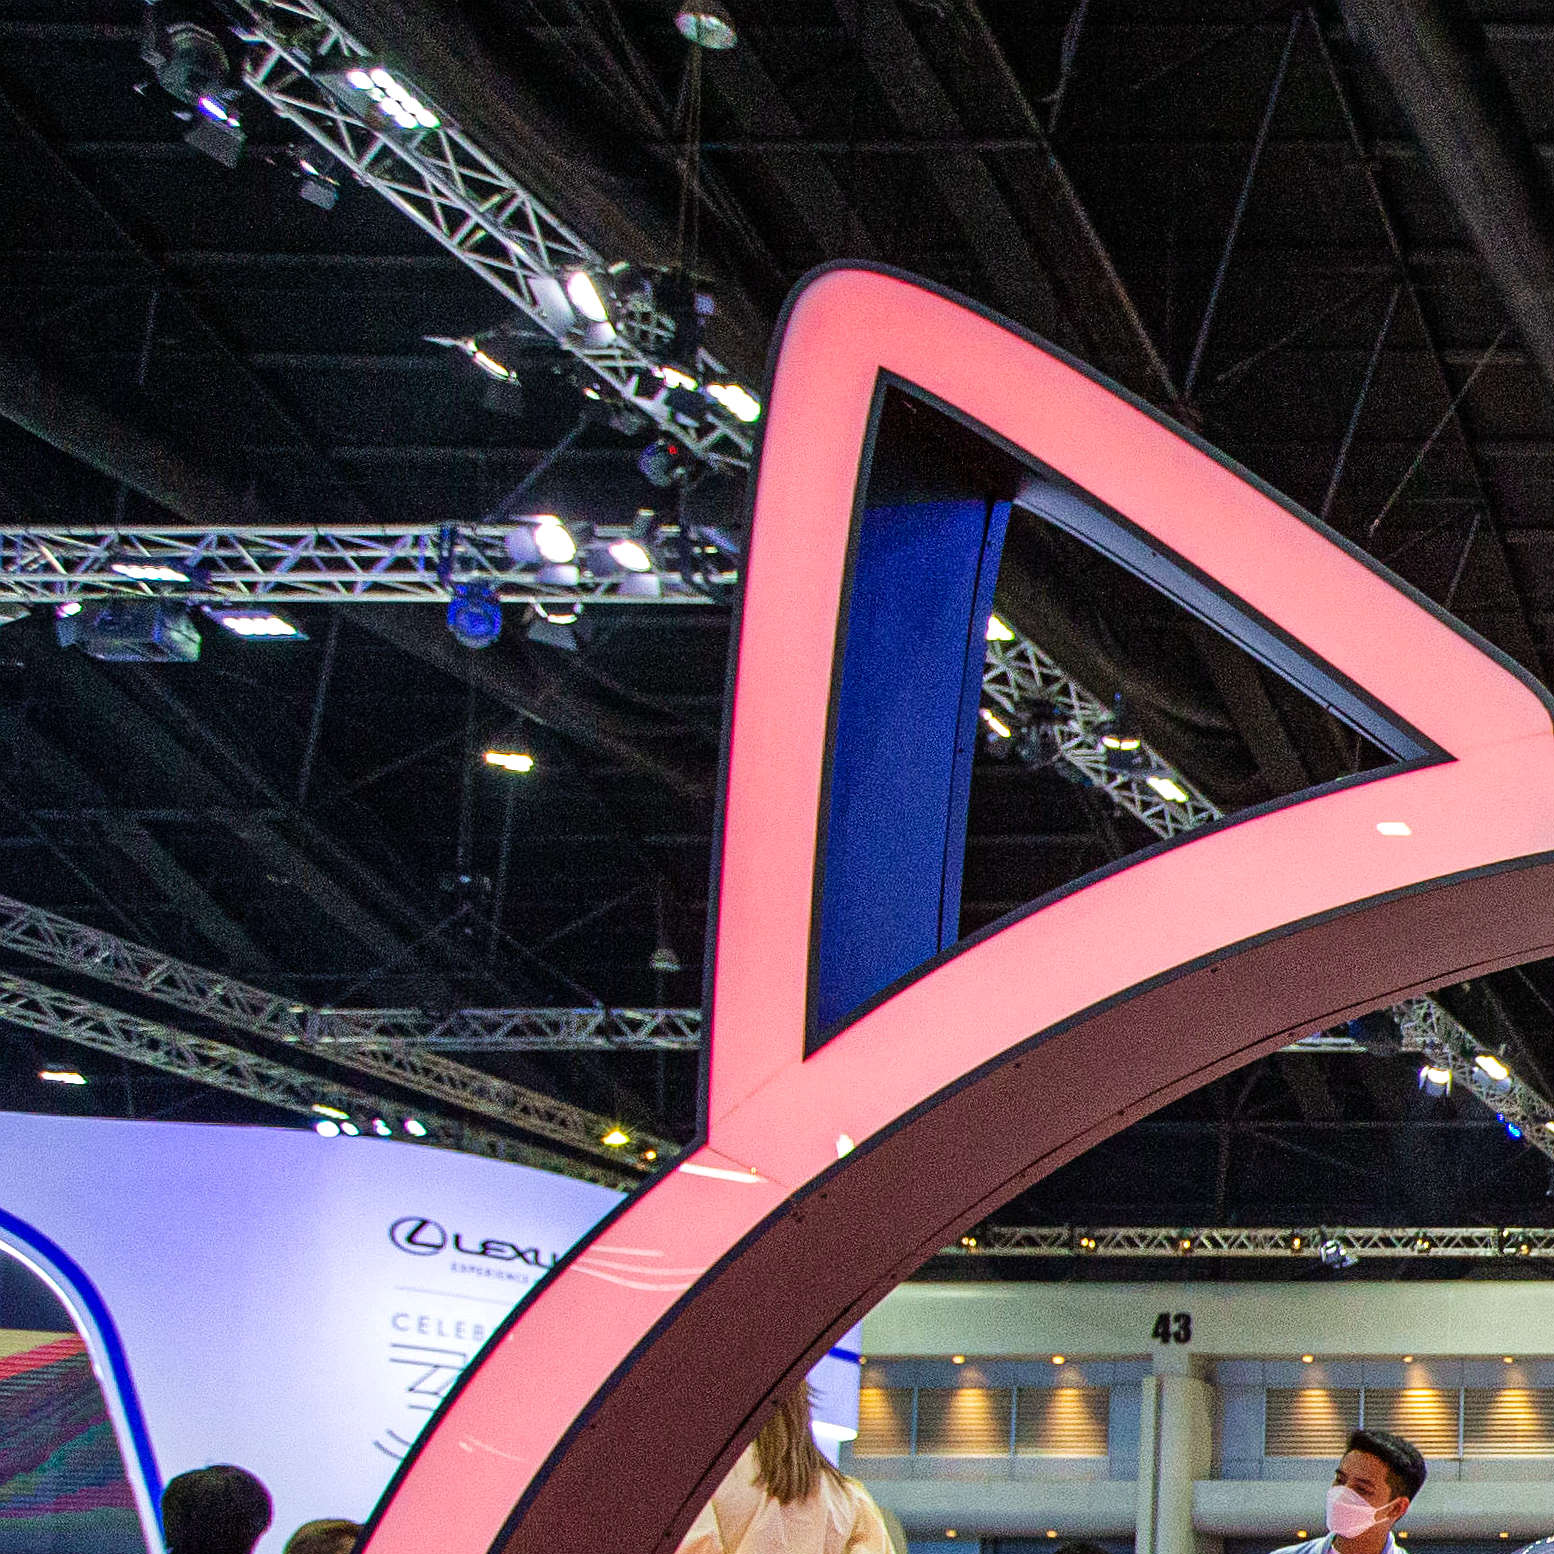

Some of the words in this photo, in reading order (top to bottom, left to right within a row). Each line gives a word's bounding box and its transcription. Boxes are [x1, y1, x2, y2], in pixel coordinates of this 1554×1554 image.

[453, 1233, 558, 1269] LEXU
[391, 1311, 488, 1341] CELEB
[1152, 1313, 1193, 1344] 43
